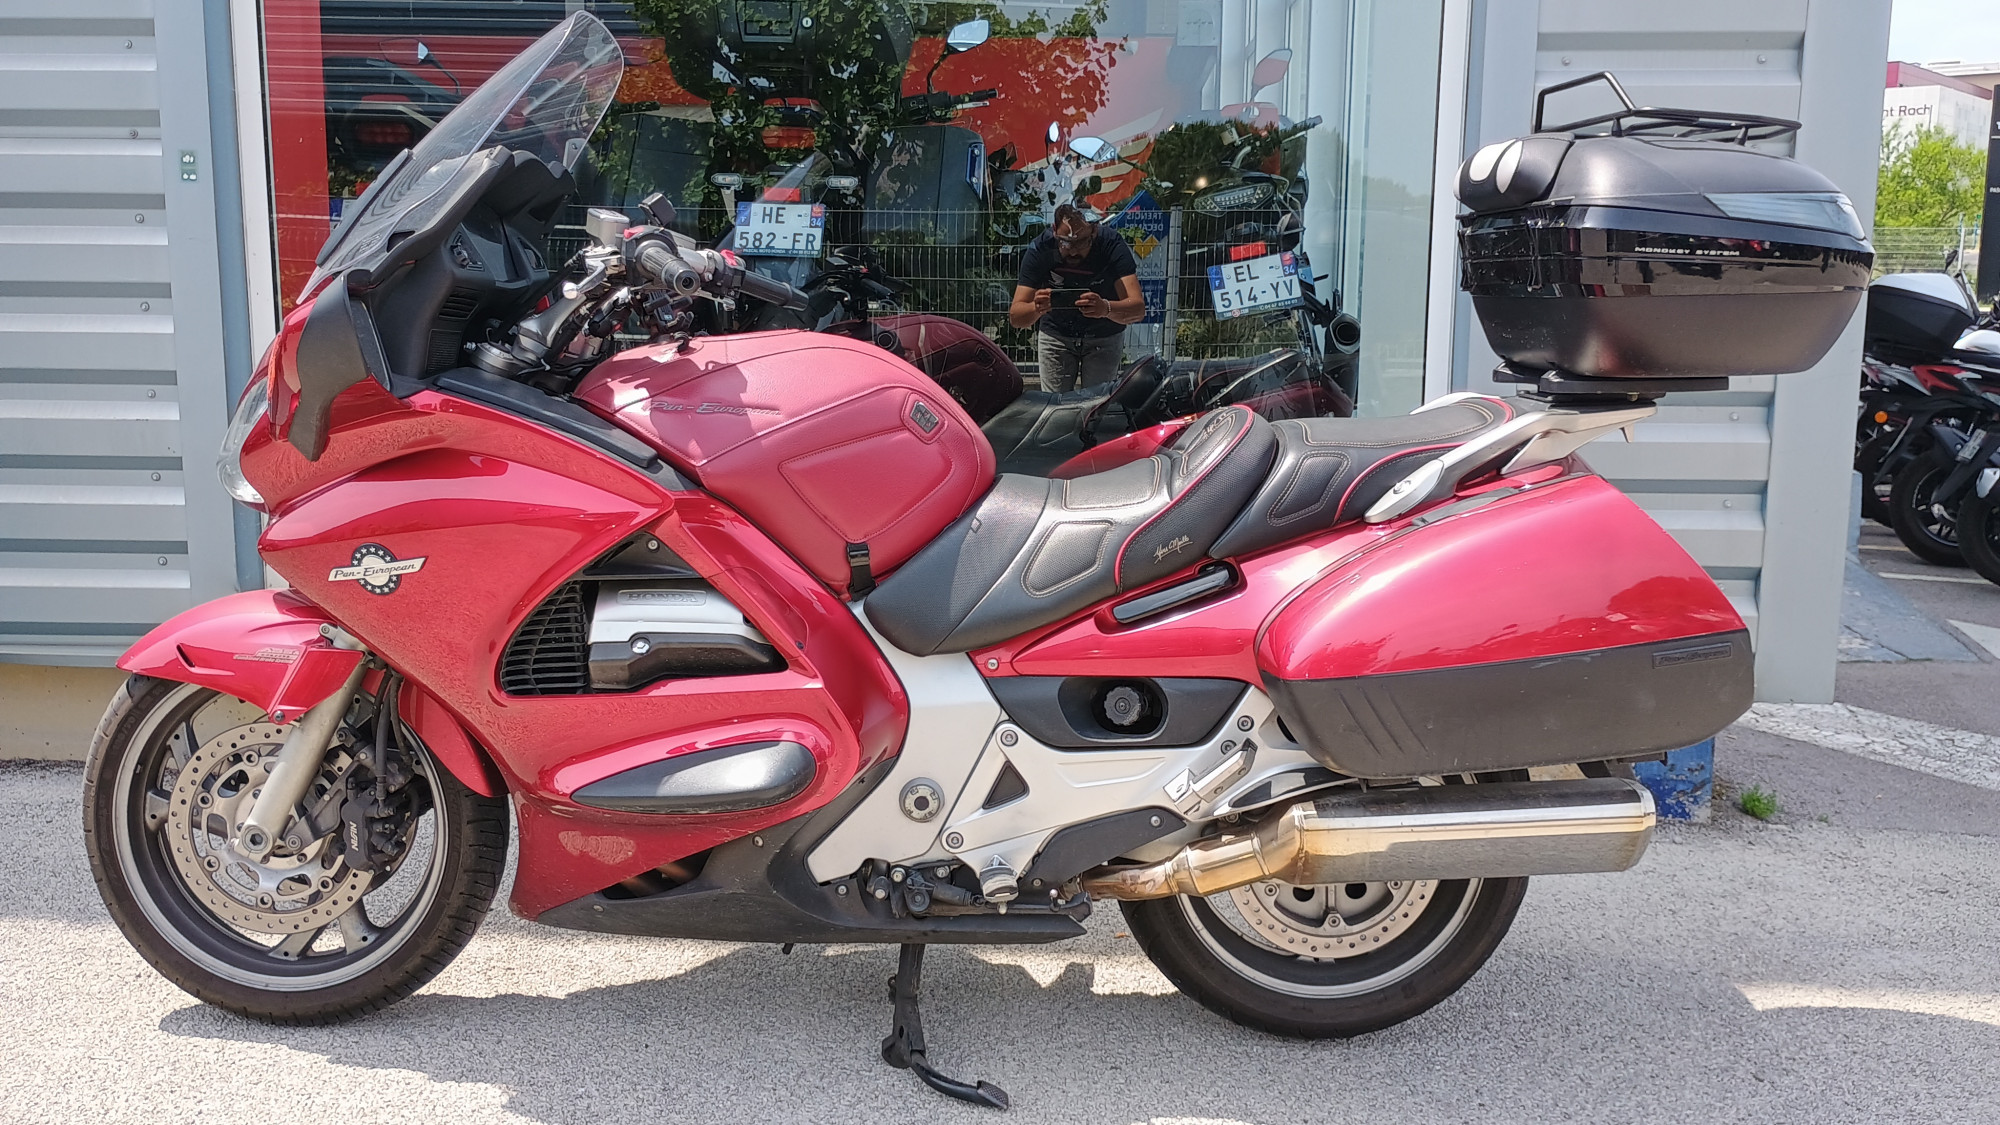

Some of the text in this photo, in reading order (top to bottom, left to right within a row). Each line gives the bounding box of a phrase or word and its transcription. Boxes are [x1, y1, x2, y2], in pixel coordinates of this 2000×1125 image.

[1898, 104, 1930, 116] Roch
[761, 206, 786, 224] HE
[810, 218, 821, 227] 34
[739, 231, 816, 250] 582-FR
[1634, 246, 1690, 254] MONOKEY
[1233, 263, 1260, 283] EL
[1283, 264, 1295, 275] 34
[1220, 279, 1293, 308] 514-YV
[334, 563, 416, 579] Pan-European
[627, 592, 698, 603] HONDA
